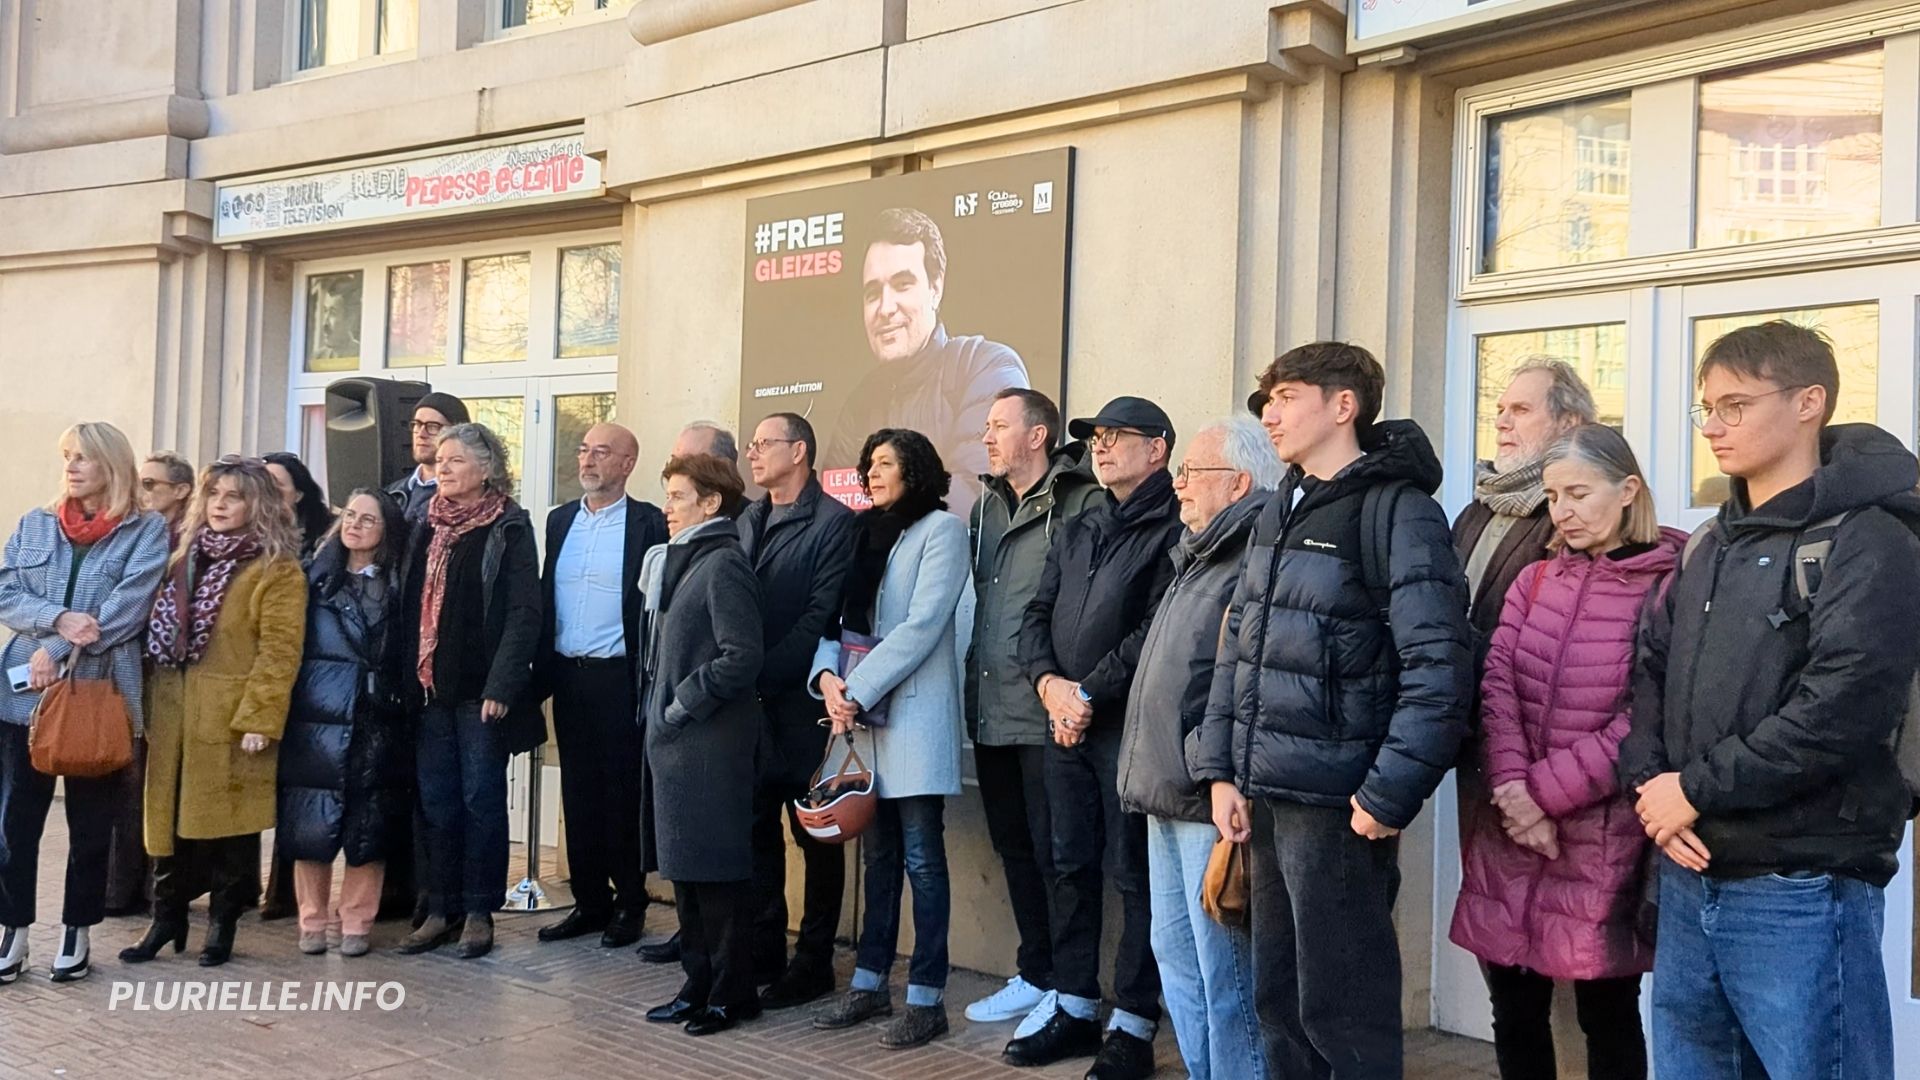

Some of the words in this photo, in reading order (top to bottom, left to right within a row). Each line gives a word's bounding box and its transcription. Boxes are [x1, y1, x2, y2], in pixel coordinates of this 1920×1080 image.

[351, 167, 407, 199] RADIO
[955, 193, 978, 217] RSF
[755, 212, 844, 254] #FREE
[755, 250, 843, 282] GLEIZES
[755, 386, 780, 398] SIGNEZ
[780, 385, 789, 396] LA
[790, 381, 823, 394] PÉTITION
[830, 473, 842, 487] LE
